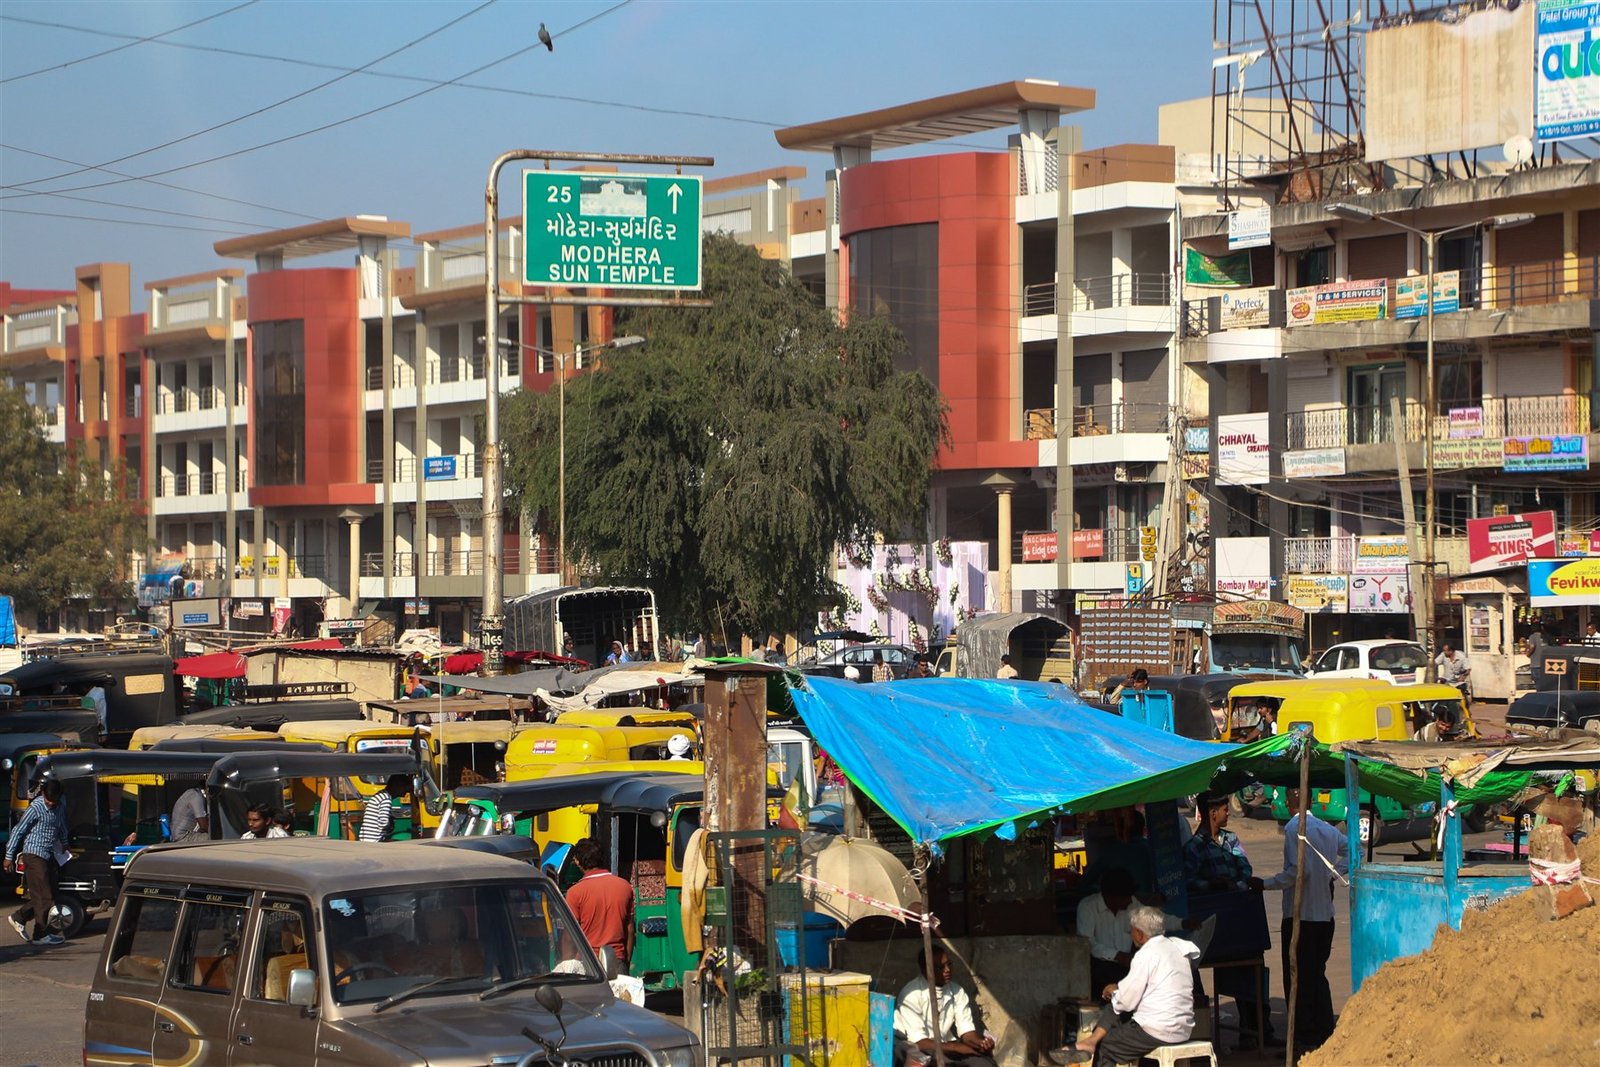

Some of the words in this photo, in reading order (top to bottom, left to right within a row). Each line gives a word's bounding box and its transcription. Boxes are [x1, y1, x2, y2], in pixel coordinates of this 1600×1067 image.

[1562, 7, 1588, 21] Group
[547, 186, 572, 203] 25
[561, 245, 662, 265] MODHERA
[549, 264, 589, 282] SUN
[597, 264, 675, 283] TEMPLE
[1342, 288, 1382, 298] SERVICES
[1235, 297, 1263, 309] Perfect
[1219, 433, 1258, 446] CHHAYAL
[1496, 538, 1534, 554] KINGS
[1217, 580, 1246, 592] Bombay
[1248, 579, 1268, 590] Metal
[1550, 576, 1579, 589] Fevi
[1226, 614, 1252, 622] GOODS
[90, 992, 105, 1002] TOYOTA
